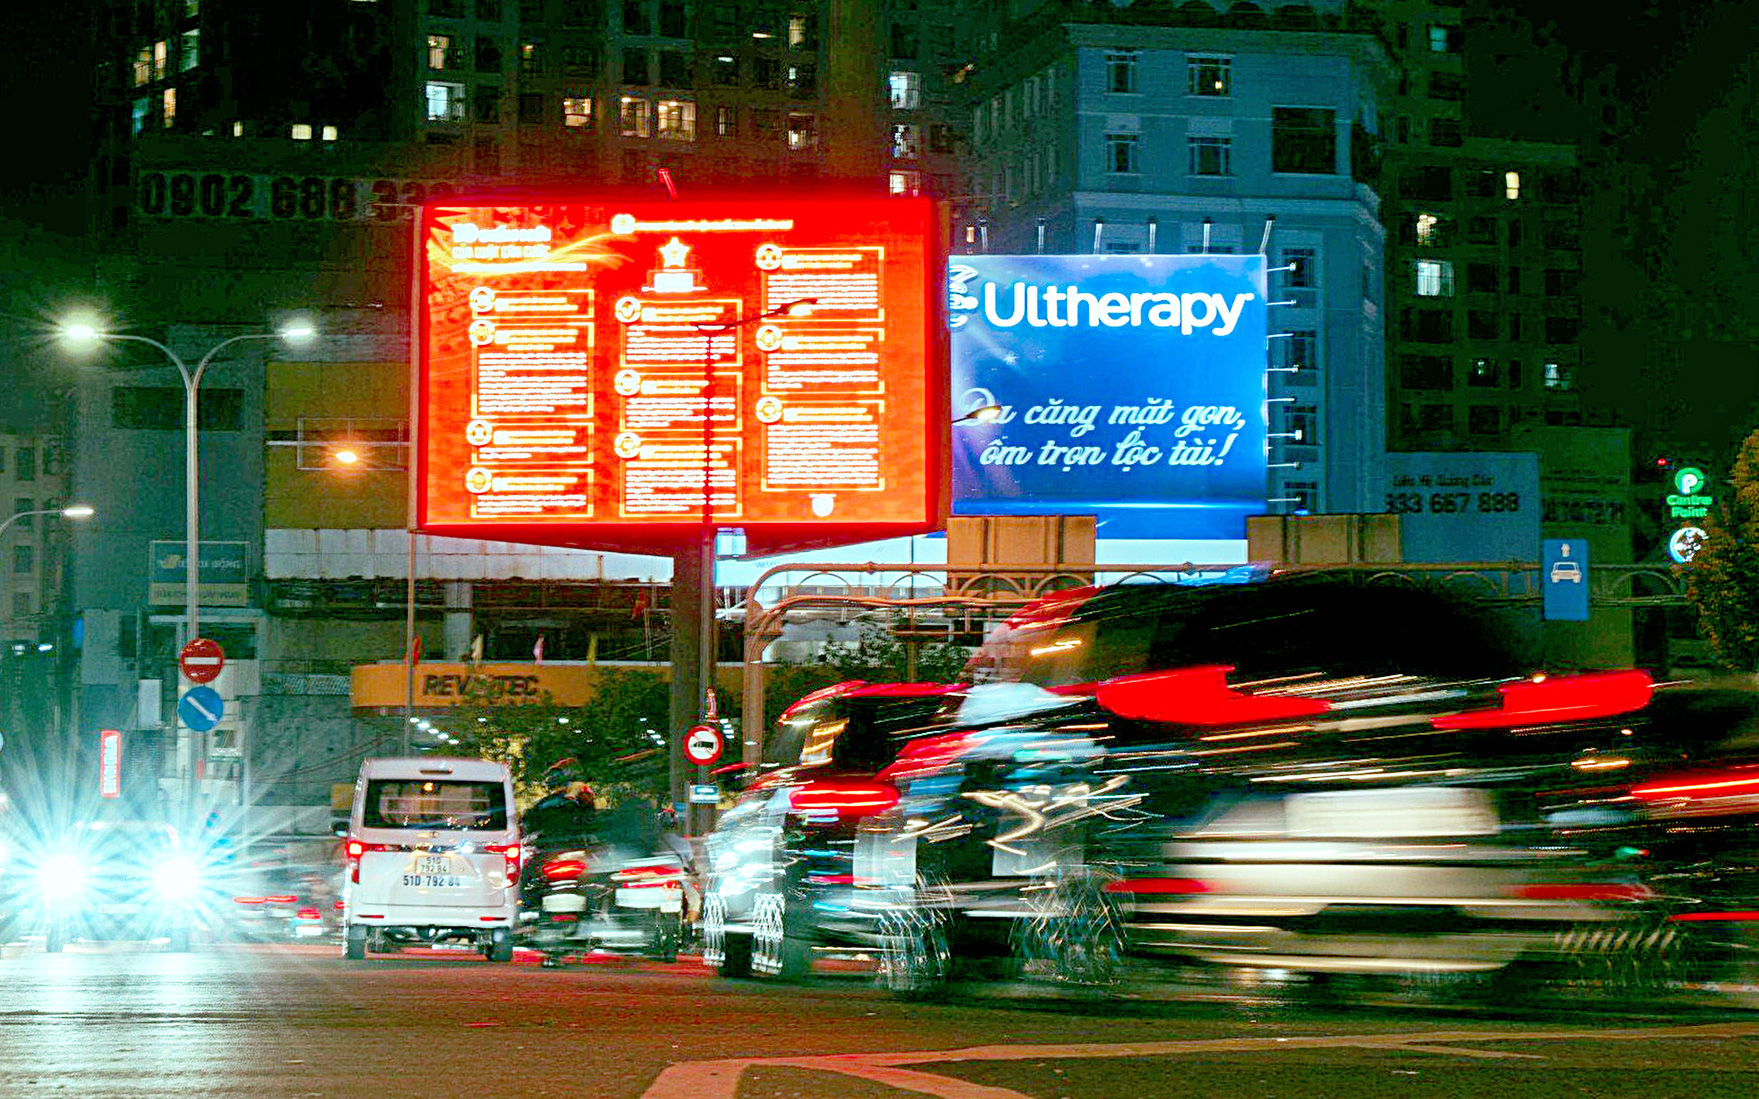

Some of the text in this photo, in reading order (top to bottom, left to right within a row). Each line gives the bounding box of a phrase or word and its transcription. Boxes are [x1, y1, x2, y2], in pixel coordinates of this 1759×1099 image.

[141, 172, 254, 217] 0902
[984, 282, 1253, 336] Ultherapy
[1024, 398, 1101, 438] căng
[1107, 397, 1175, 431] mặt
[1037, 440, 1107, 472] trọn
[1111, 430, 1164, 472] lộc
[1168, 433, 1239, 466] tài!
[1671, 507, 1708, 518] Point
